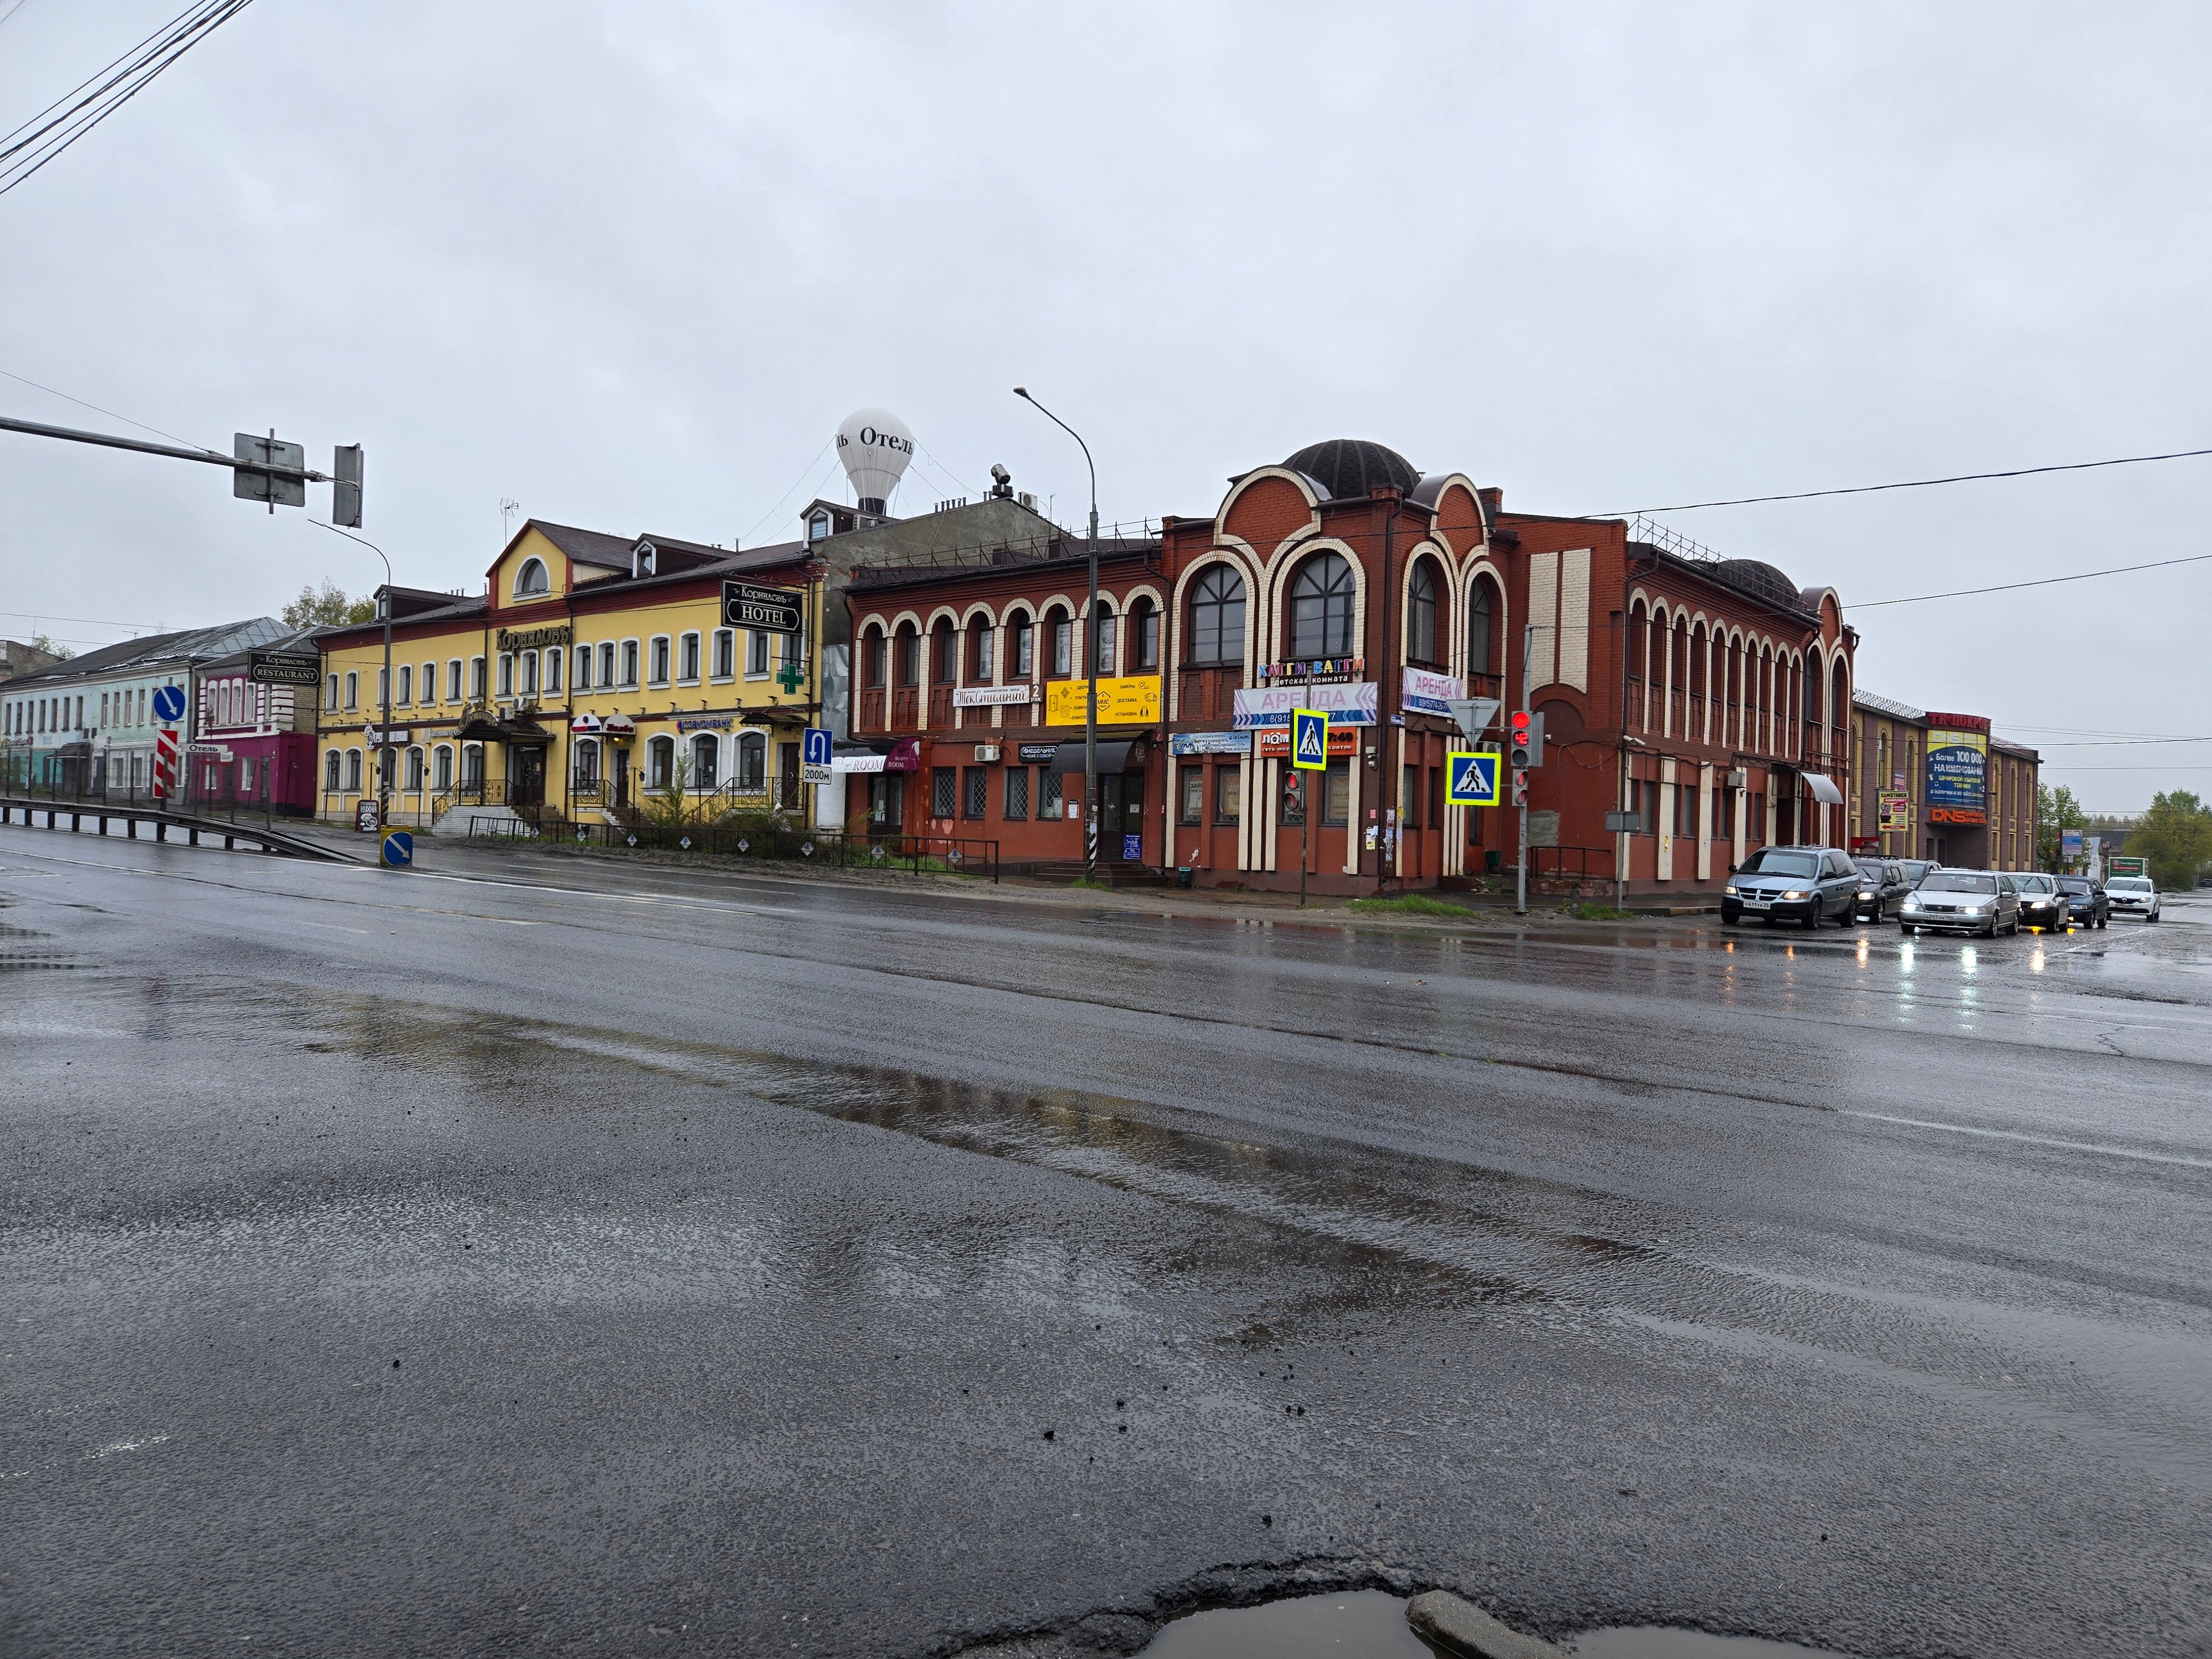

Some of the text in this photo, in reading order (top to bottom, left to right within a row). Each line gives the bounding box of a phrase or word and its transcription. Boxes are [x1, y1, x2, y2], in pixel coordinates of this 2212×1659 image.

[860, 426, 913, 455] Отель
[742, 606, 786, 624] HOTEL
[257, 669, 315, 679] RESTAURANT
[1258, 658, 1365, 678] ХАГГИ ВАГГИ
[1274, 675, 1348, 686] детская комната
[1415, 675, 1452, 700] АРЕНДА
[1032, 685, 1039, 697] 2
[1261, 690, 1346, 710] АРЕНДА
[1515, 733, 1528, 745] 42
[1936, 751, 1983, 764] Более 100 000
[852, 759, 885, 771] ROOM
[1931, 808, 1965, 823] DNS
